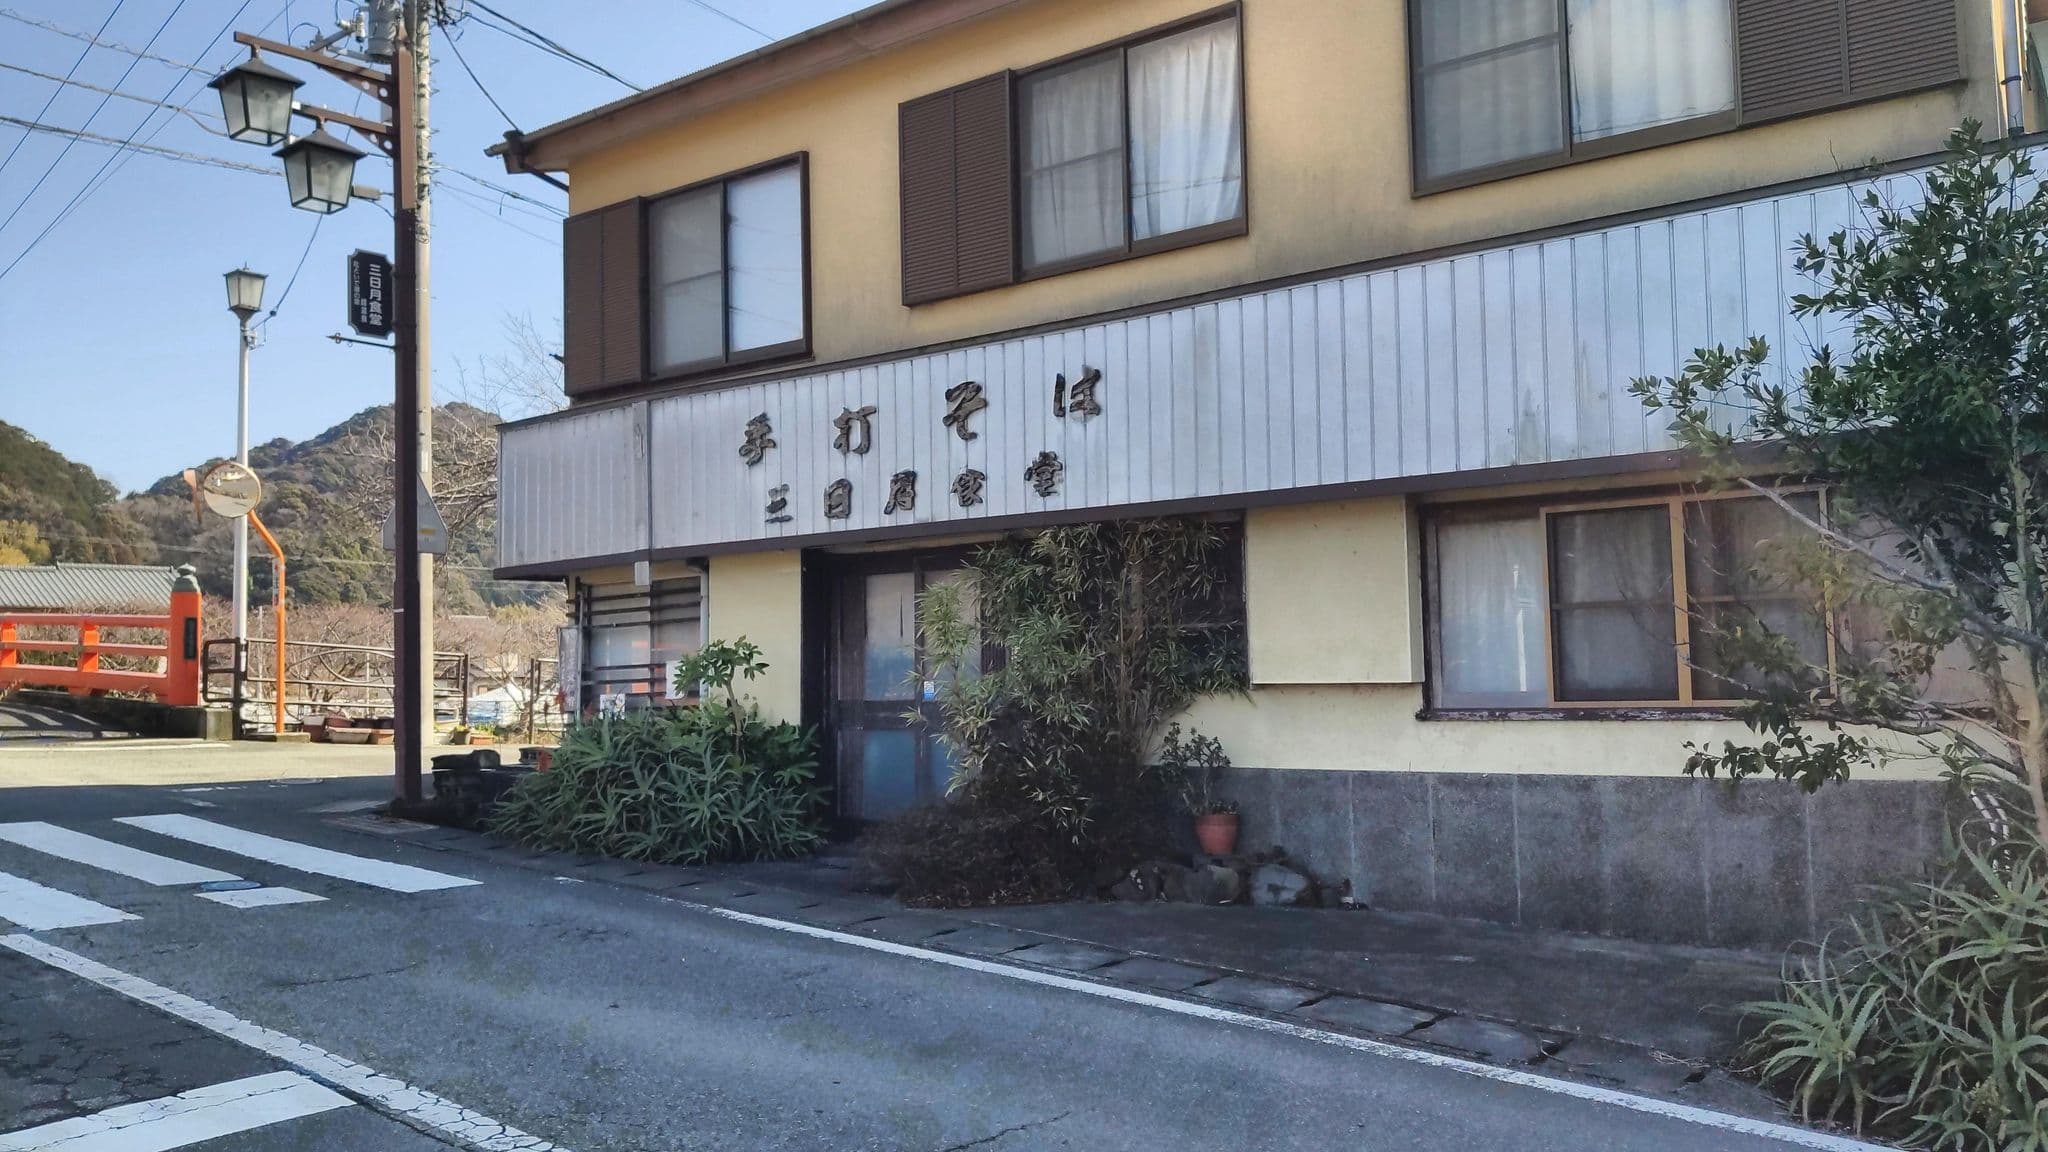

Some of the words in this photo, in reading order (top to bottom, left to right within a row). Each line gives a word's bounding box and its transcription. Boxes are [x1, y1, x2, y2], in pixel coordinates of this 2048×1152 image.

[369, 263, 382, 326] 三日月食堂
[738, 365, 1102, 468] 手打そば
[764, 450, 1064, 524] 三日月食堂
